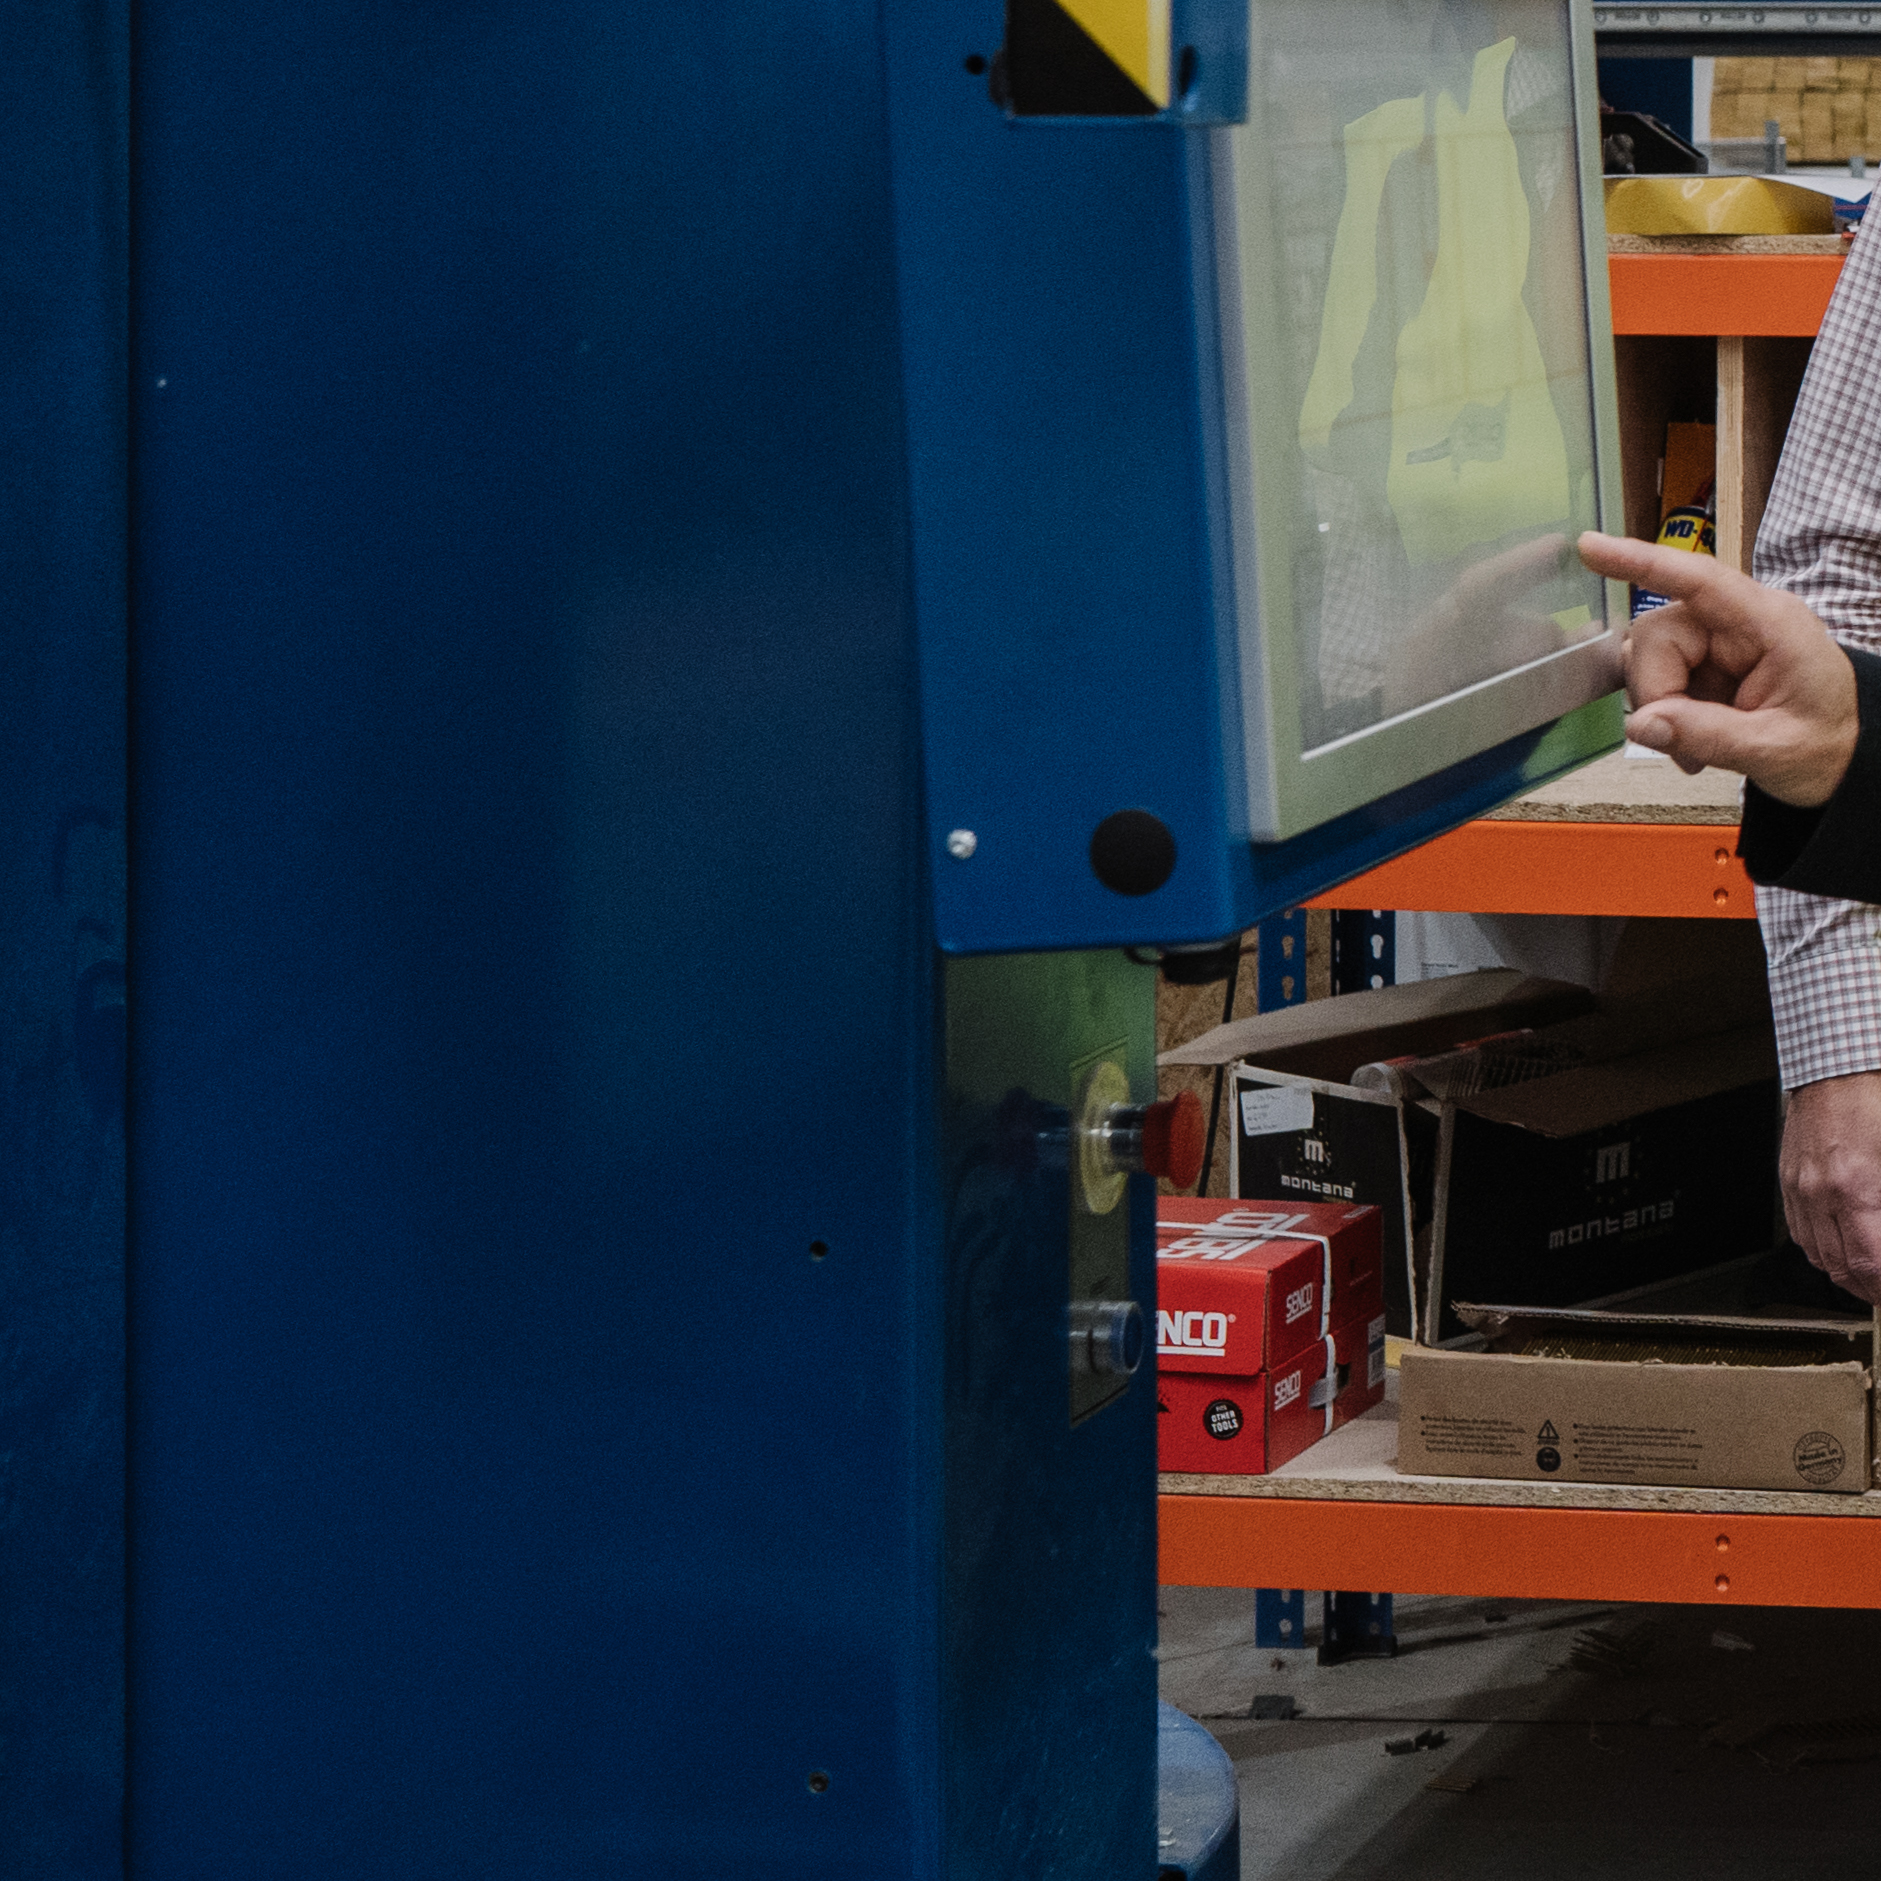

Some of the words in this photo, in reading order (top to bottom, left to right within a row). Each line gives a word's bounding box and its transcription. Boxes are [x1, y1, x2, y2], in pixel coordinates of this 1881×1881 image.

[1281, 1174, 1354, 1199] montana
[1548, 1199, 1675, 1250] montana
[1285, 1282, 1314, 1319] SENCO
[1156, 1310, 1228, 1348] NCO
[1274, 1369, 1301, 1407] SENCO
[1211, 1410, 1236, 1423] OTHER
[1211, 1418, 1239, 1433] TOOLS
